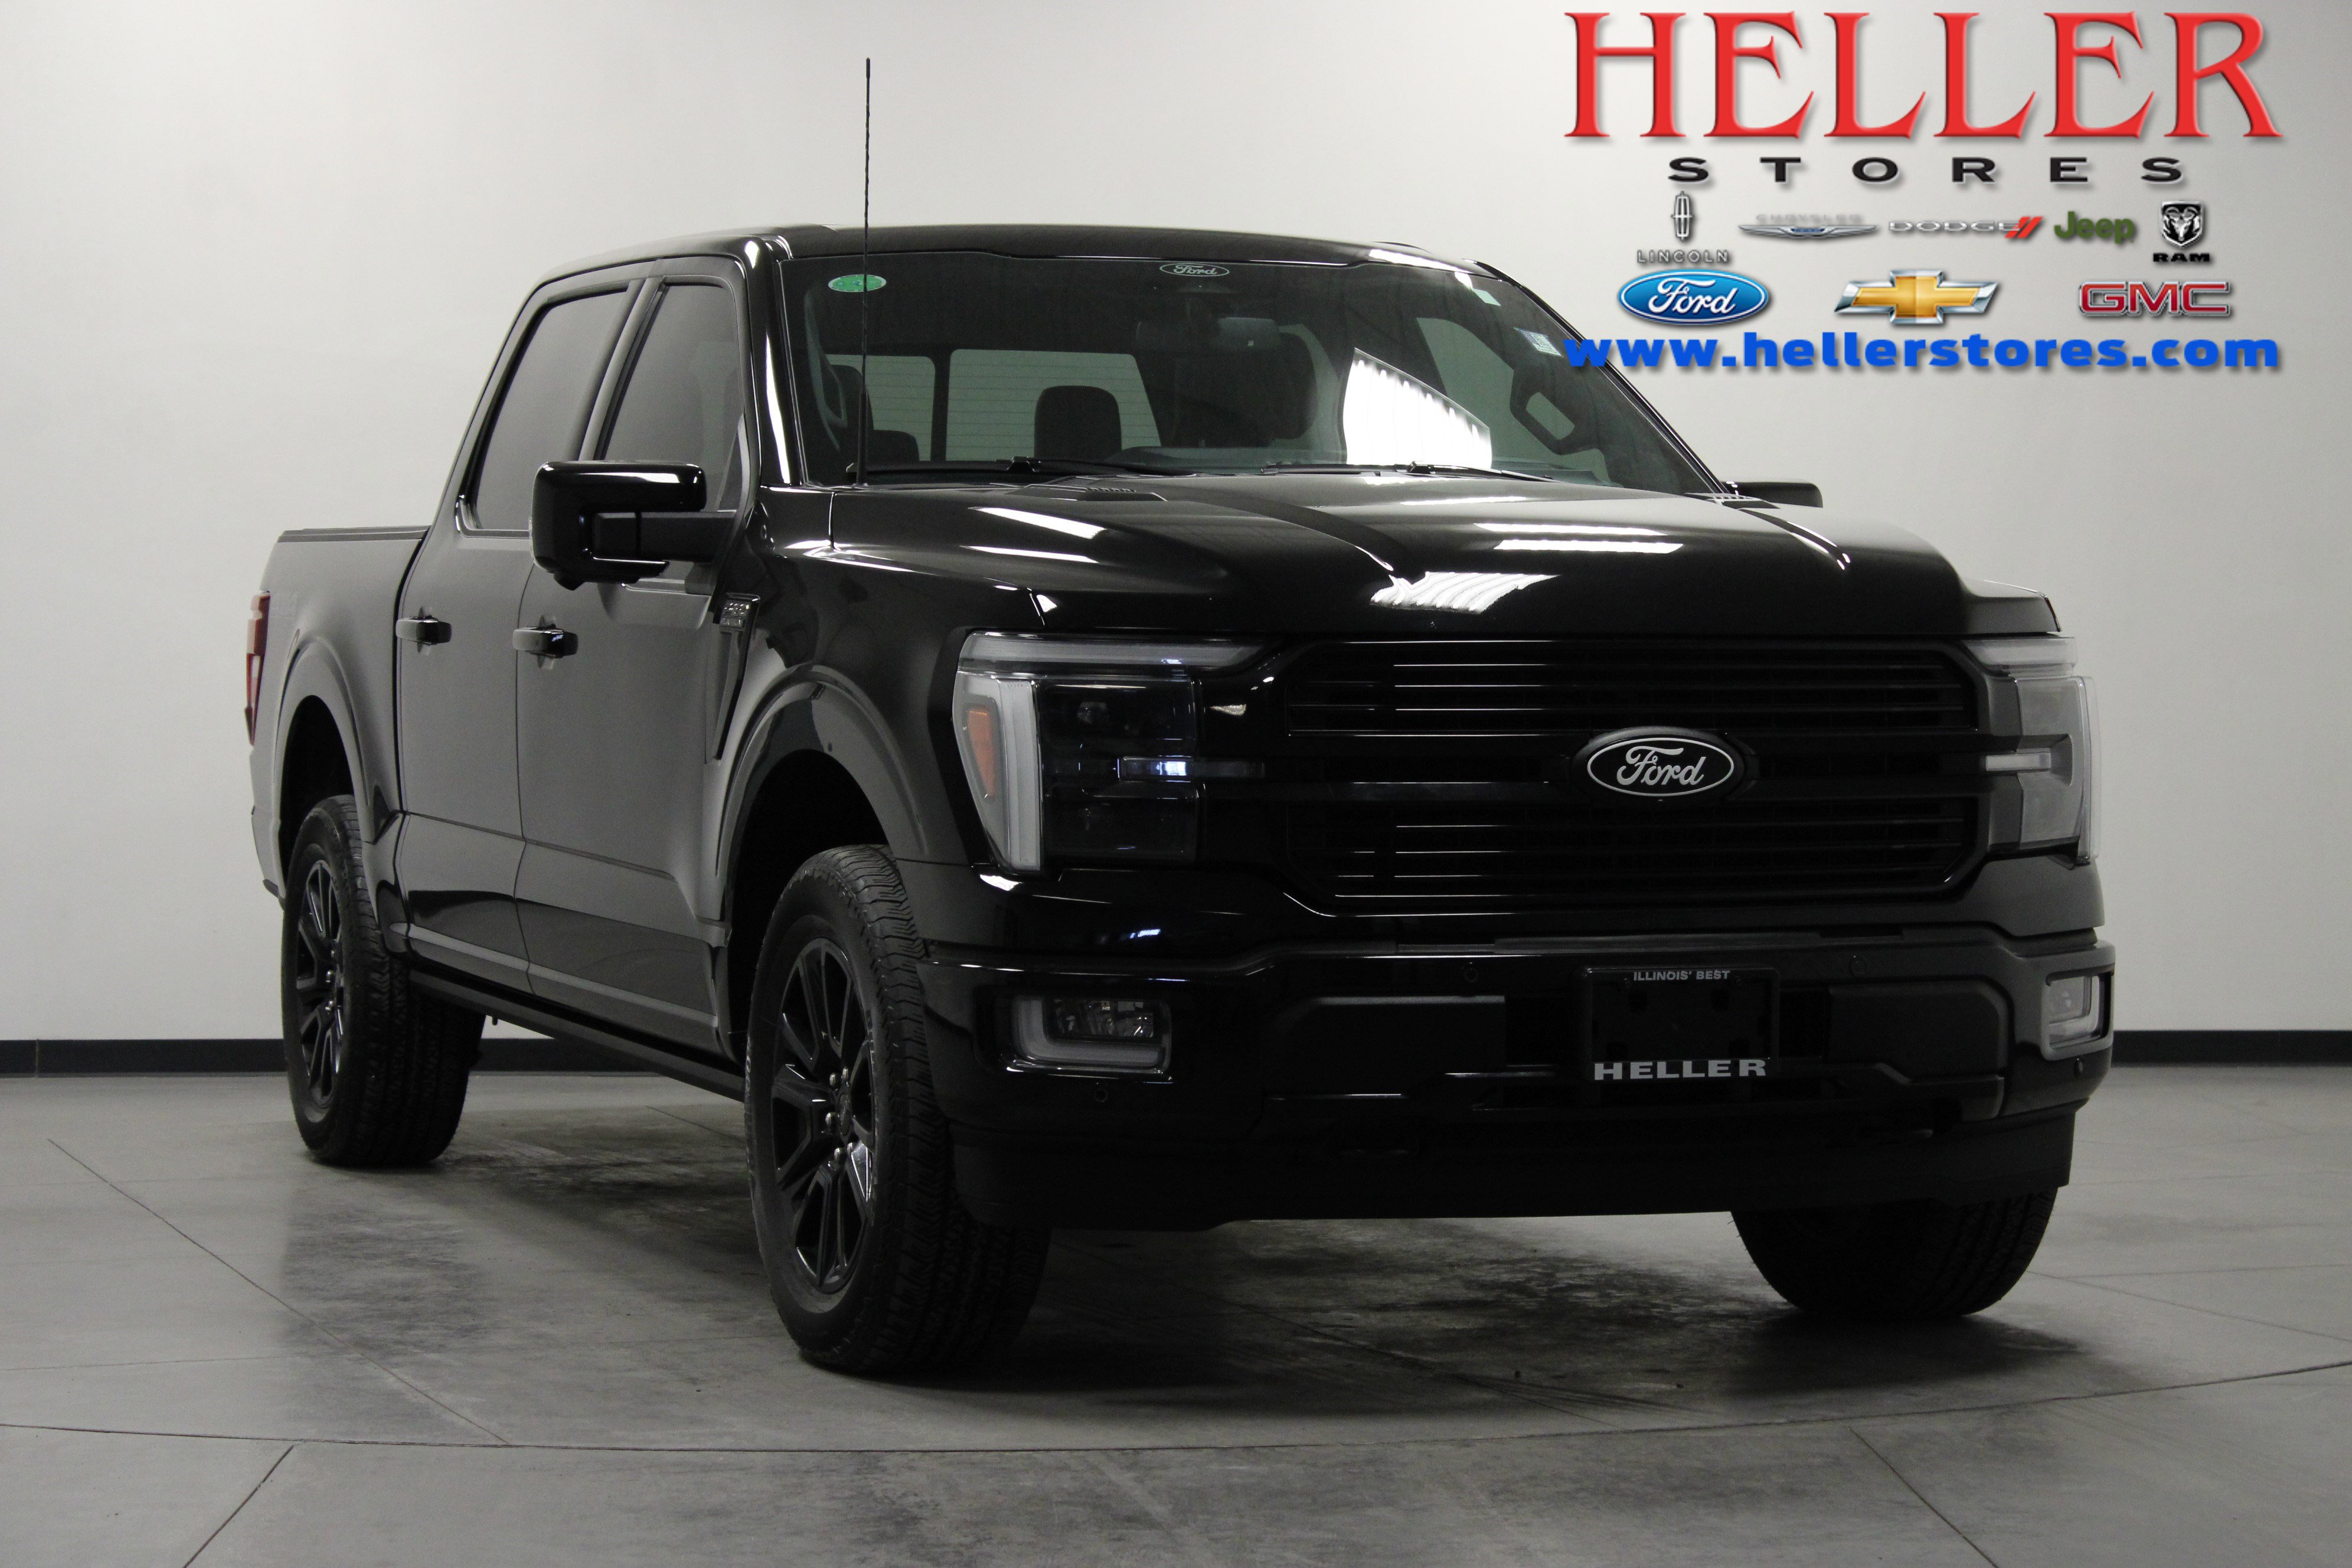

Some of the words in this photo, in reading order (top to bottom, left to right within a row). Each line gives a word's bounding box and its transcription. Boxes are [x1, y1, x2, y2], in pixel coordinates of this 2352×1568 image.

[1173, 264, 1218, 275] Ford
[1616, 745, 1707, 786] Ford
[1634, 971, 1692, 981] ILLINOIS'
[1696, 970, 1730, 980] BEST
[1594, 1059, 1766, 1080] HELLER
